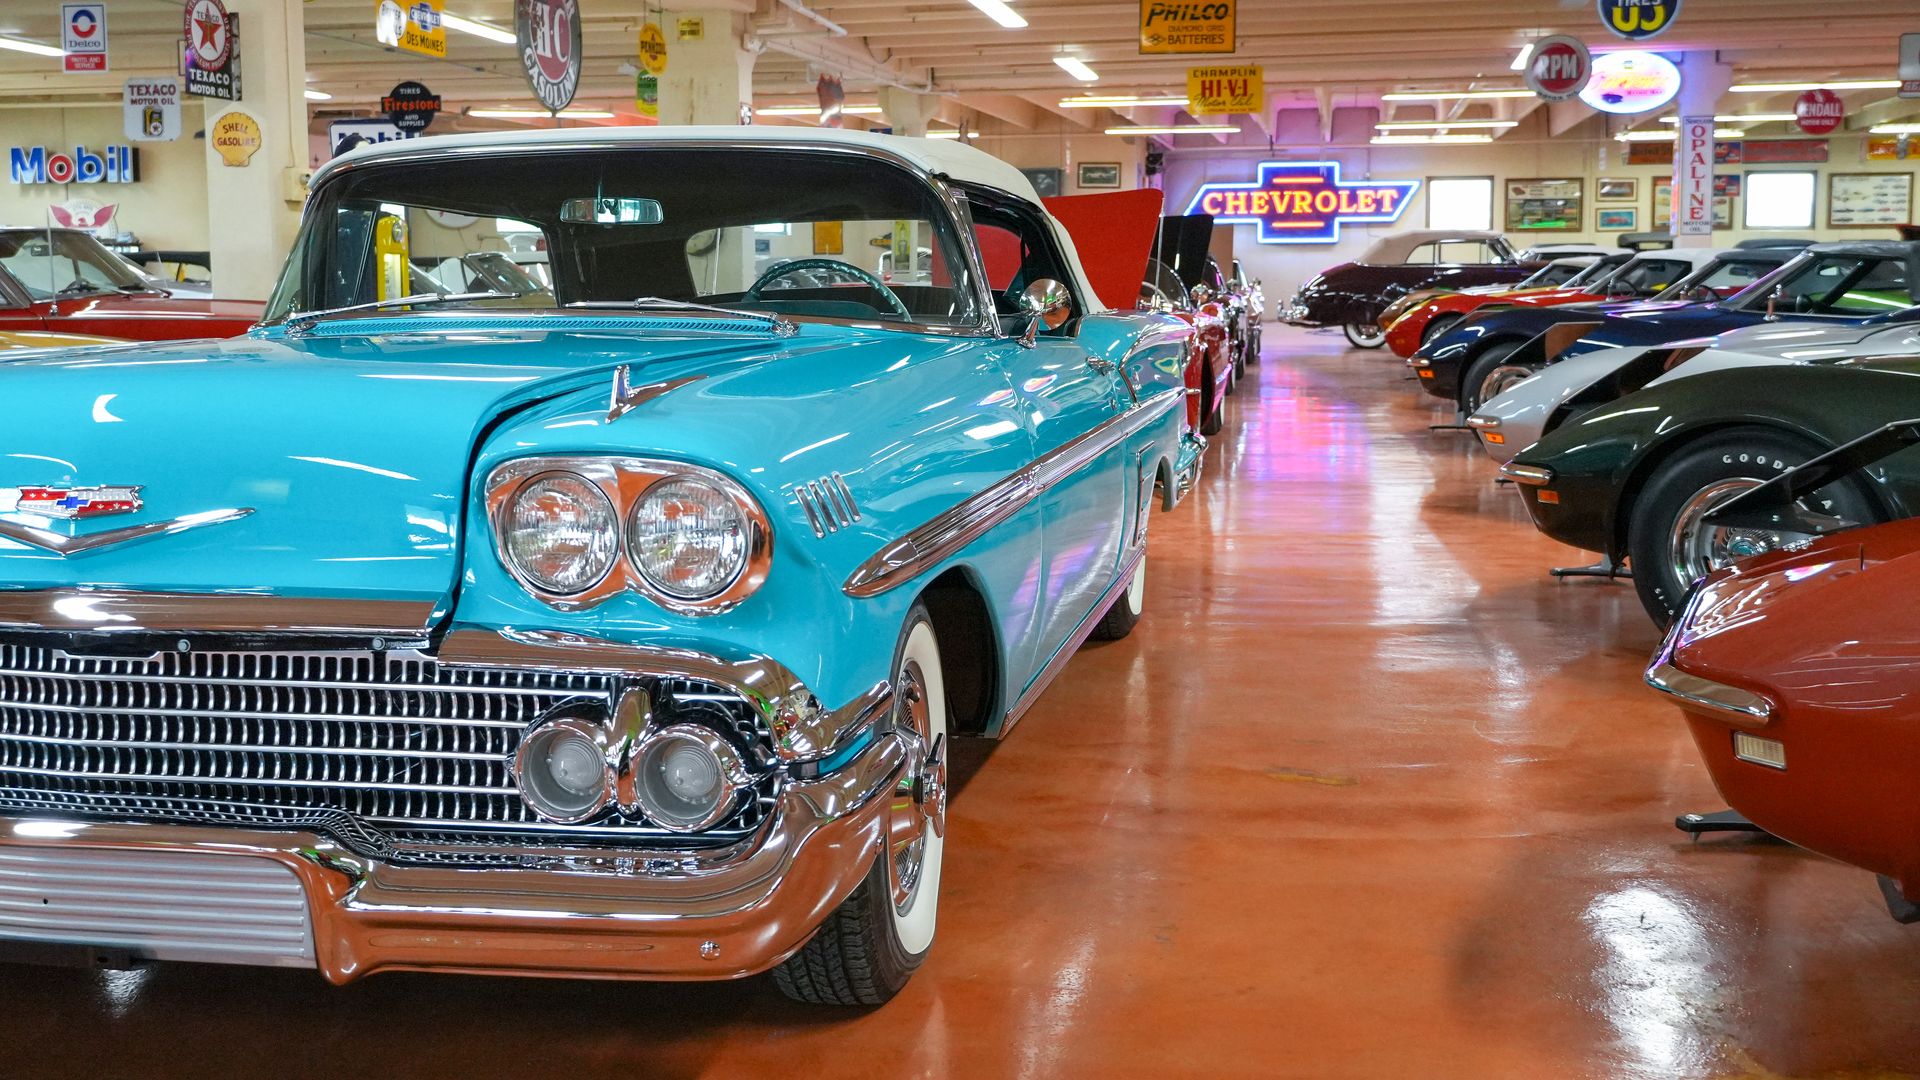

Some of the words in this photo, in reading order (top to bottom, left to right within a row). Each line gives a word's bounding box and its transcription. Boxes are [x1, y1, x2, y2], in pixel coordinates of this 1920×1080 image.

[1146, 3, 1229, 27] PHILCO
[68, 40, 101, 48] Delco
[406, 31, 419, 46] DES
[419, 34, 445, 53] MOINES
[1168, 34, 1225, 45] BATTERIES
[1193, 69, 1257, 78] CHAMPLIN
[1531, 53, 1578, 80] RPM
[189, 68, 230, 85] TEXACO
[128, 84, 176, 96] TEXACO
[190, 83, 216, 96] MOTOR
[218, 87, 230, 98] OIL
[400, 87, 421, 95] TIRES
[383, 97, 440, 112] Firestone
[223, 122, 248, 134] SHELL
[217, 136, 256, 147] GASOLINE
[10, 144, 134, 185] Mobil
[1689, 125, 1706, 220] OPALINE
[1202, 190, 1399, 216] CHEVROLET
